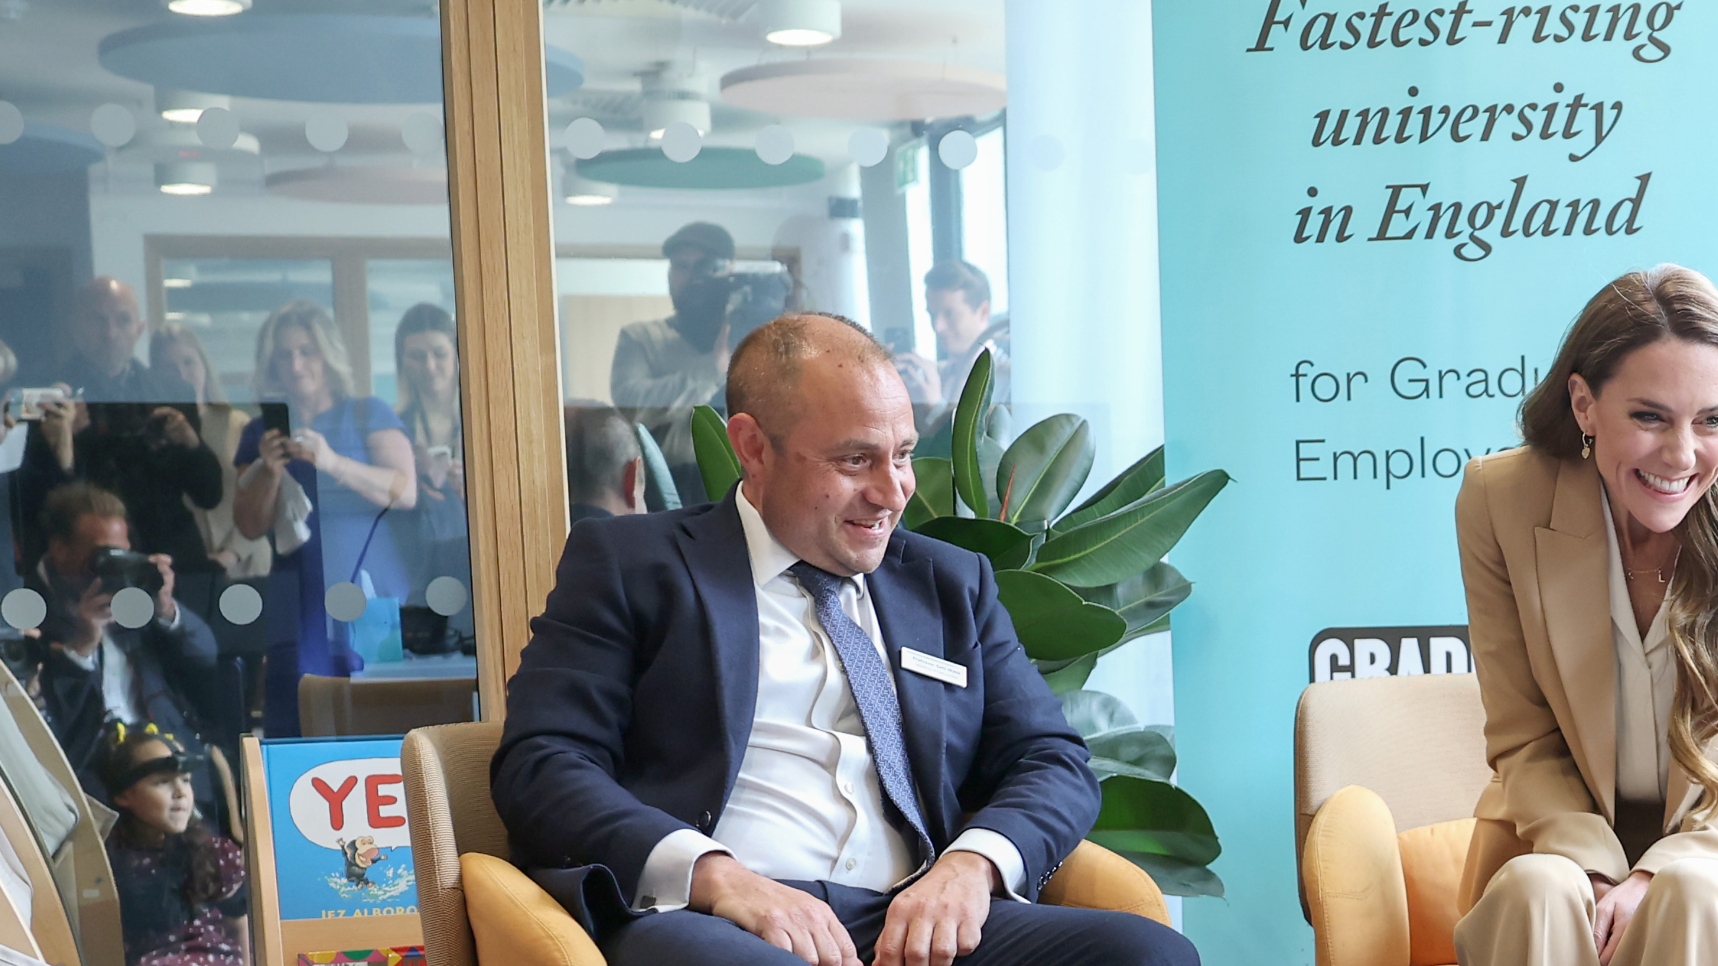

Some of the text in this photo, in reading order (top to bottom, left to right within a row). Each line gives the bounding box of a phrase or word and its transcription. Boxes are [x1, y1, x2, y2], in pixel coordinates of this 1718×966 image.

[1245, 0, 1685, 63] Fastest-rising
[1311, 82, 1623, 162] university
[1293, 171, 1653, 262] in England
[1290, 360, 1369, 402] for
[1295, 436, 1516, 490] Emplo
[1314, 636, 1478, 683] GRAD
[311, 773, 407, 831] YE
